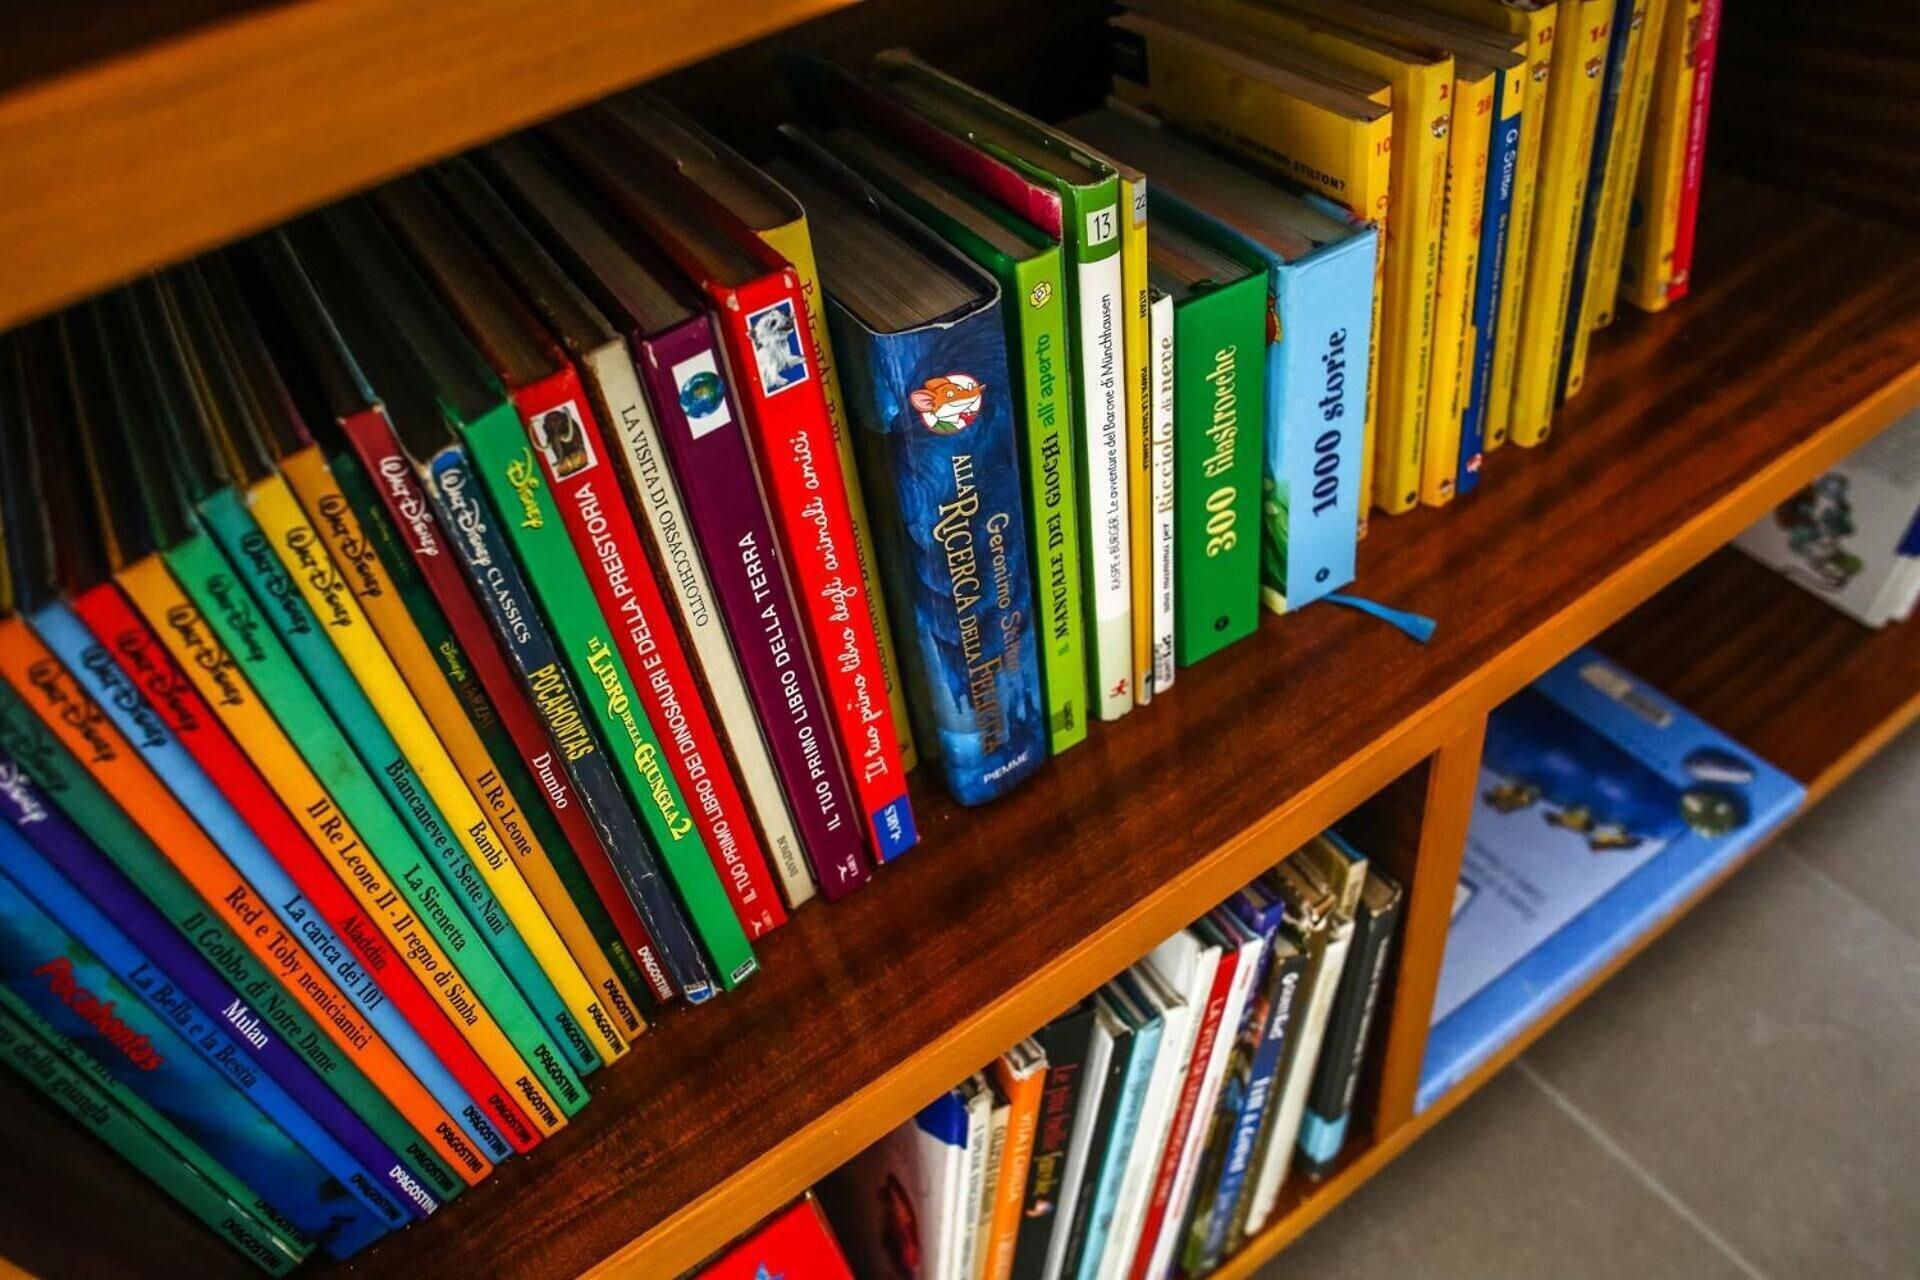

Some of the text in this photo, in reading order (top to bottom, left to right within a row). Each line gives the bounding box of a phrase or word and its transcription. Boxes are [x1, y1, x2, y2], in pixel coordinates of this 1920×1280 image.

[1439, 83, 1449, 101] 2
[1094, 212, 1111, 242] 13
[1035, 333, 1057, 398] aperto
[1099, 293, 1114, 376] Münchhausen
[1161, 336, 1174, 393] neve
[1101, 375, 1114, 391] di
[1103, 390, 1116, 430] Barone
[1103, 427, 1116, 450] del
[1312, 328, 1348, 518] 1000 storie
[506, 446, 544, 530] Disney
[789, 429, 820, 491] amici
[1106, 449, 1119, 500] avventure
[379, 456, 439, 557] Walt Disney
[621, 404, 709, 627] LA VISITA DI ORSACCHIOTTO
[801, 495, 839, 571] animali
[1107, 501, 1119, 514] Le
[1162, 523, 1174, 542] per
[1206, 485, 1238, 558] 300
[286, 525, 353, 628] Walt Disney
[318, 493, 384, 597] Walt Disney
[440, 469, 532, 644] Walt Disney CLASSICS
[933, 453, 983, 662] ALLA RICERCA DELLA
[986, 512, 1012, 609] Geronimo
[821, 576, 858, 623] degli
[1050, 552, 1071, 641] MANUALE
[837, 626, 861, 673] libro
[527, 661, 596, 763] POCAHONTAS
[574, 482, 757, 905] IL TUO PRIMO LIBRO DEI DINOSAURI E DELLA PREISTORIA
[738, 530, 842, 833] IL TUO PRIMO LIBRO DELLA TERRA
[852, 673, 884, 725] primo
[588, 642, 692, 841] LIBRO DELLA GIUNGLA 2
[983, 750, 1030, 785] PIEMME
[306, 798, 331, 820] Il
[532, 751, 568, 810] Dumbo
[319, 818, 345, 845] Re
[468, 819, 510, 872] Bambi
[476, 770, 533, 858] Il Re Leone
[338, 841, 383, 895] Leone
[385, 759, 510, 937] Biancaneve e i Sette Nani
[391, 913, 415, 935] Il
[403, 862, 468, 954] La Sirenetta
[225, 885, 373, 1051] Red e Toby nemiciamici
[283, 893, 386, 1012] La carica dei 101
[341, 915, 388, 971] Aladdin
[403, 931, 440, 972] regno
[181, 912, 339, 1075] Il Gobbo di Notre Dame
[433, 970, 456, 988] di
[444, 982, 480, 1027] Simba
[130, 962, 258, 1089] La Bella e la Bestia
[221, 998, 271, 1050] Mulan
